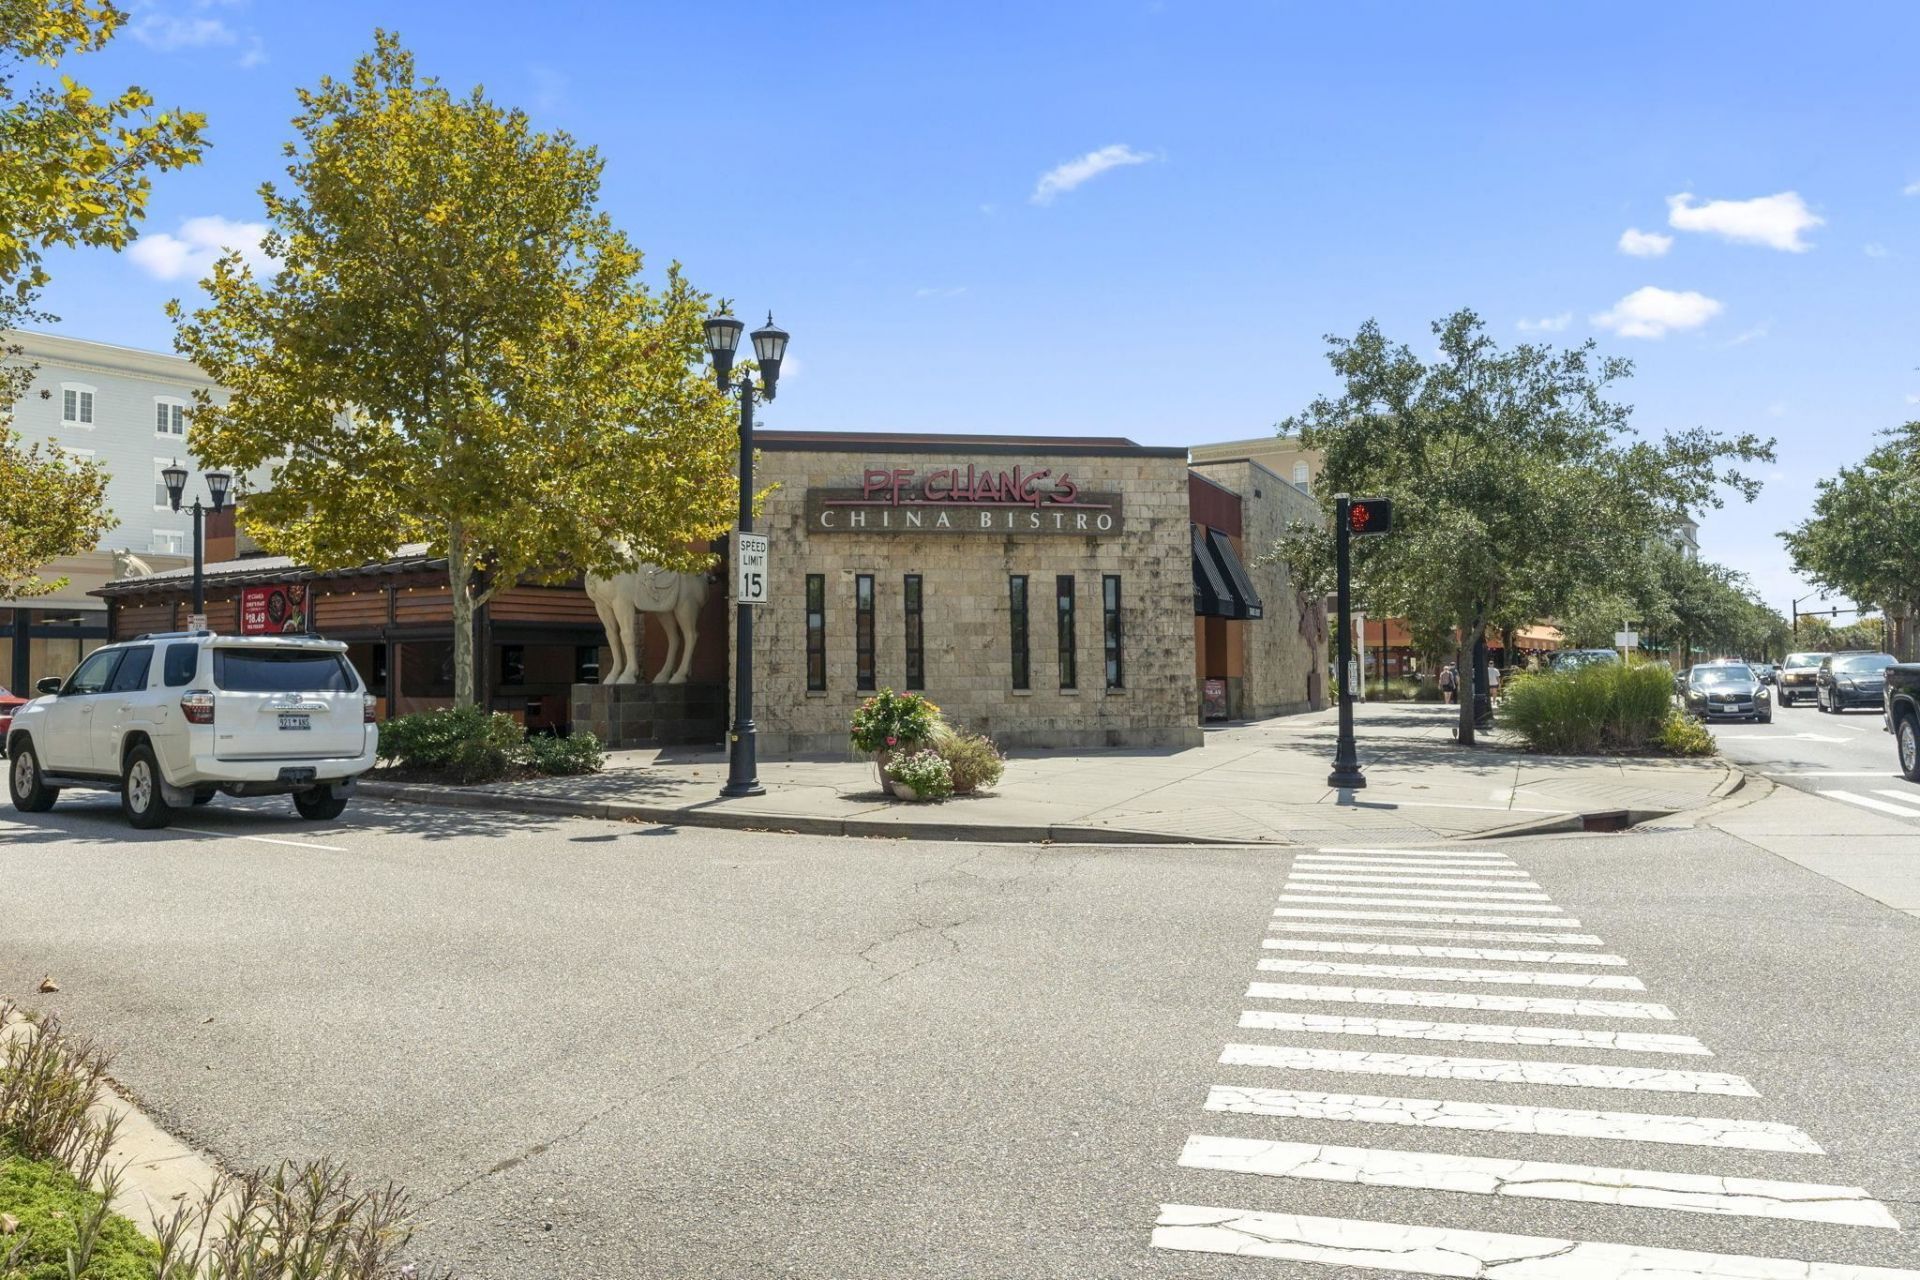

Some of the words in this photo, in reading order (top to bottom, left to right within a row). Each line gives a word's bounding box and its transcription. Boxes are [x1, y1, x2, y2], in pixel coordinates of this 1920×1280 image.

[924, 463, 1078, 509] CHANG'S
[820, 510, 951, 528] CHINA
[980, 511, 1112, 530] BISTRO
[740, 540, 766, 553] SPEED
[743, 555, 763, 566] LIMIT
[744, 572, 762, 598] 15
